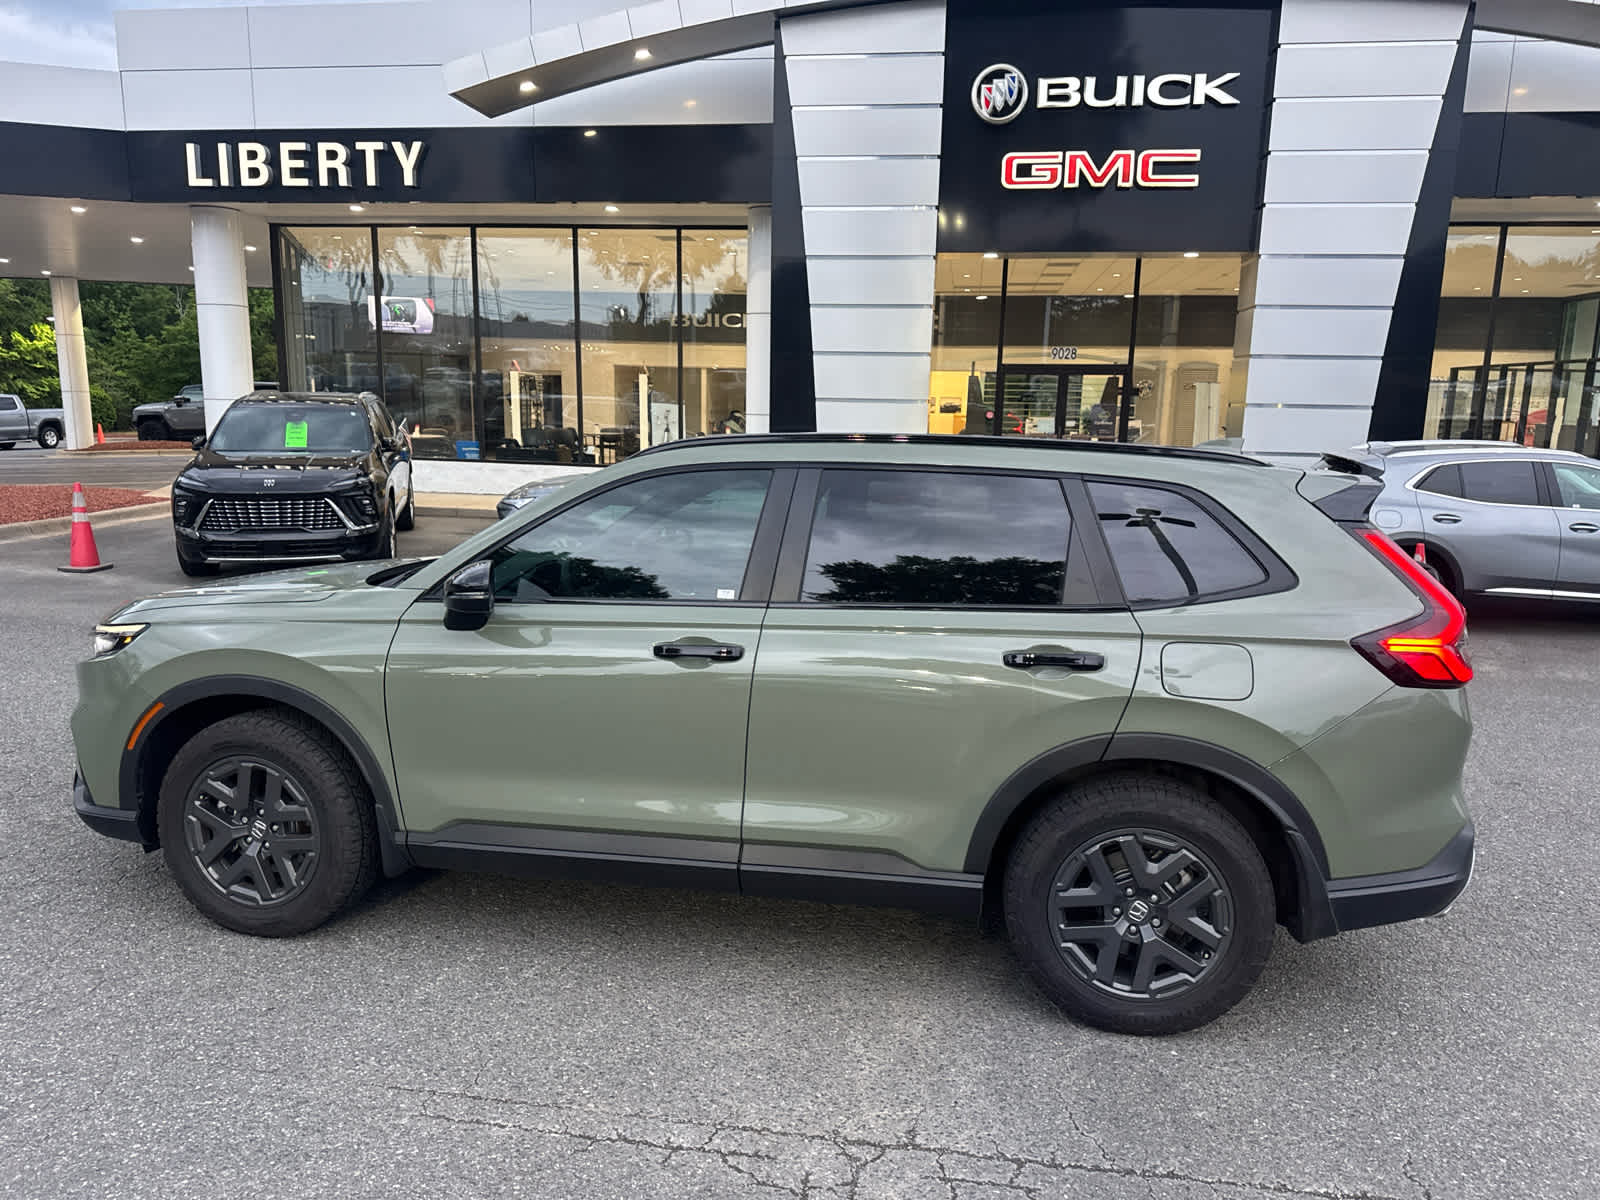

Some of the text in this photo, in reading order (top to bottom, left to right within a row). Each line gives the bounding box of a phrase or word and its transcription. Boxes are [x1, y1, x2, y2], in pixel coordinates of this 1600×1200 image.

[1036, 72, 1241, 109] BUICK
[185, 140, 424, 188] LIBERTY
[1000, 148, 1202, 190] GMC
[670, 312, 747, 329] BUIC
[1051, 346, 1078, 360] 9028
